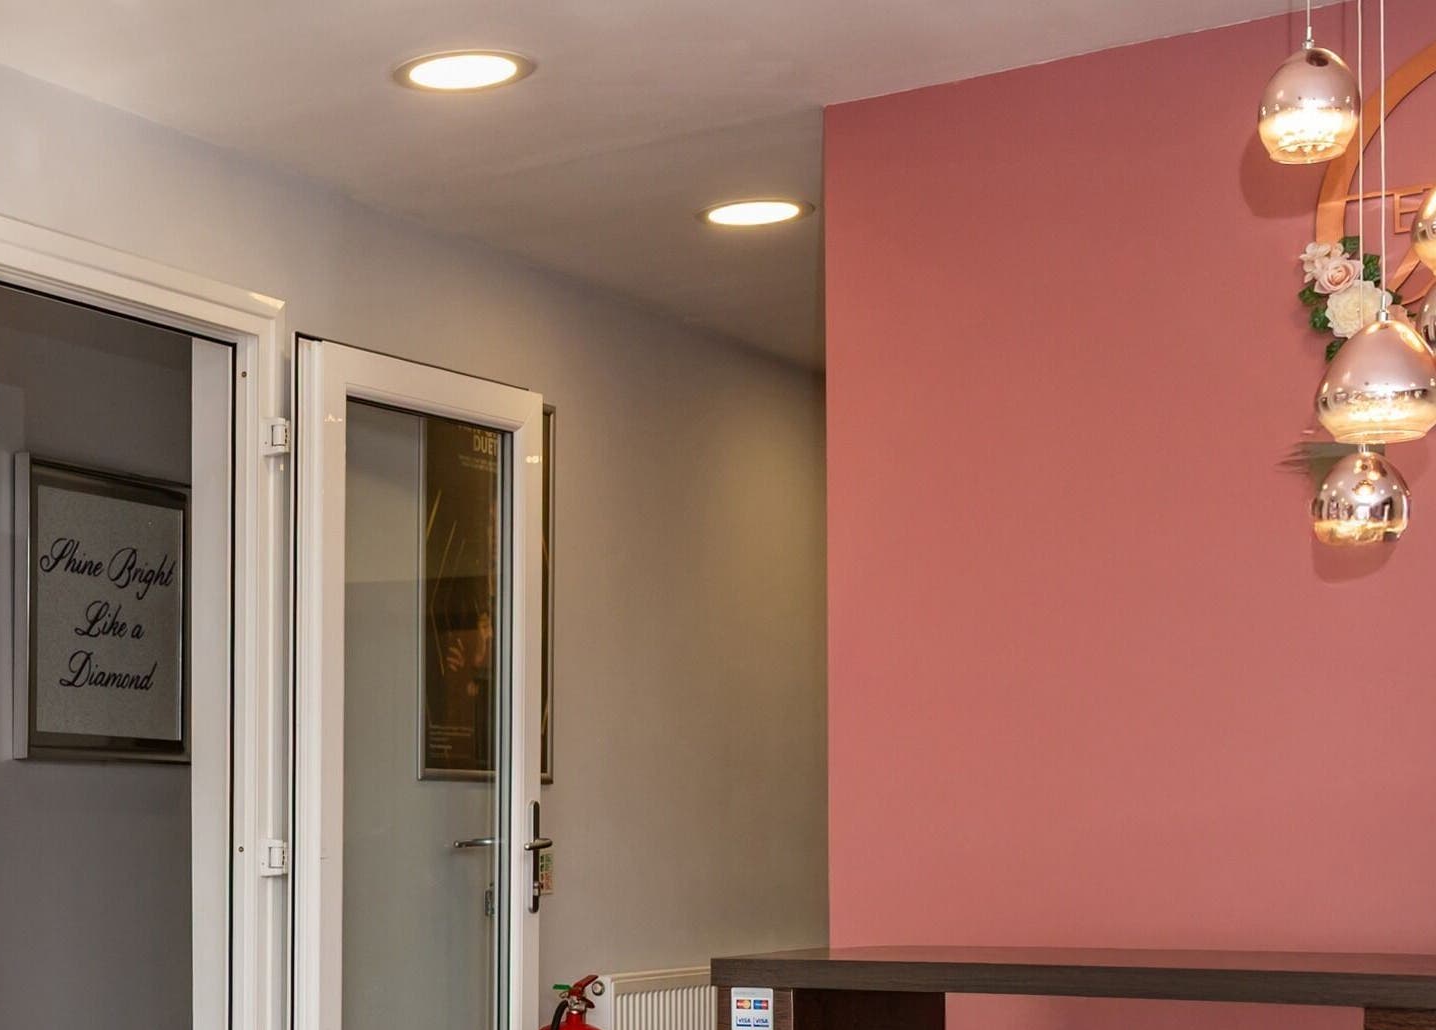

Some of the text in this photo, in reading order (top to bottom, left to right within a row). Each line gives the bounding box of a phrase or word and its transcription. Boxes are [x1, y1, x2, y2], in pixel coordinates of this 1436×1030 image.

[40, 537, 176, 600] Shine Bright
[74, 600, 144, 639] Like a
[59, 650, 158, 691] Diamond
